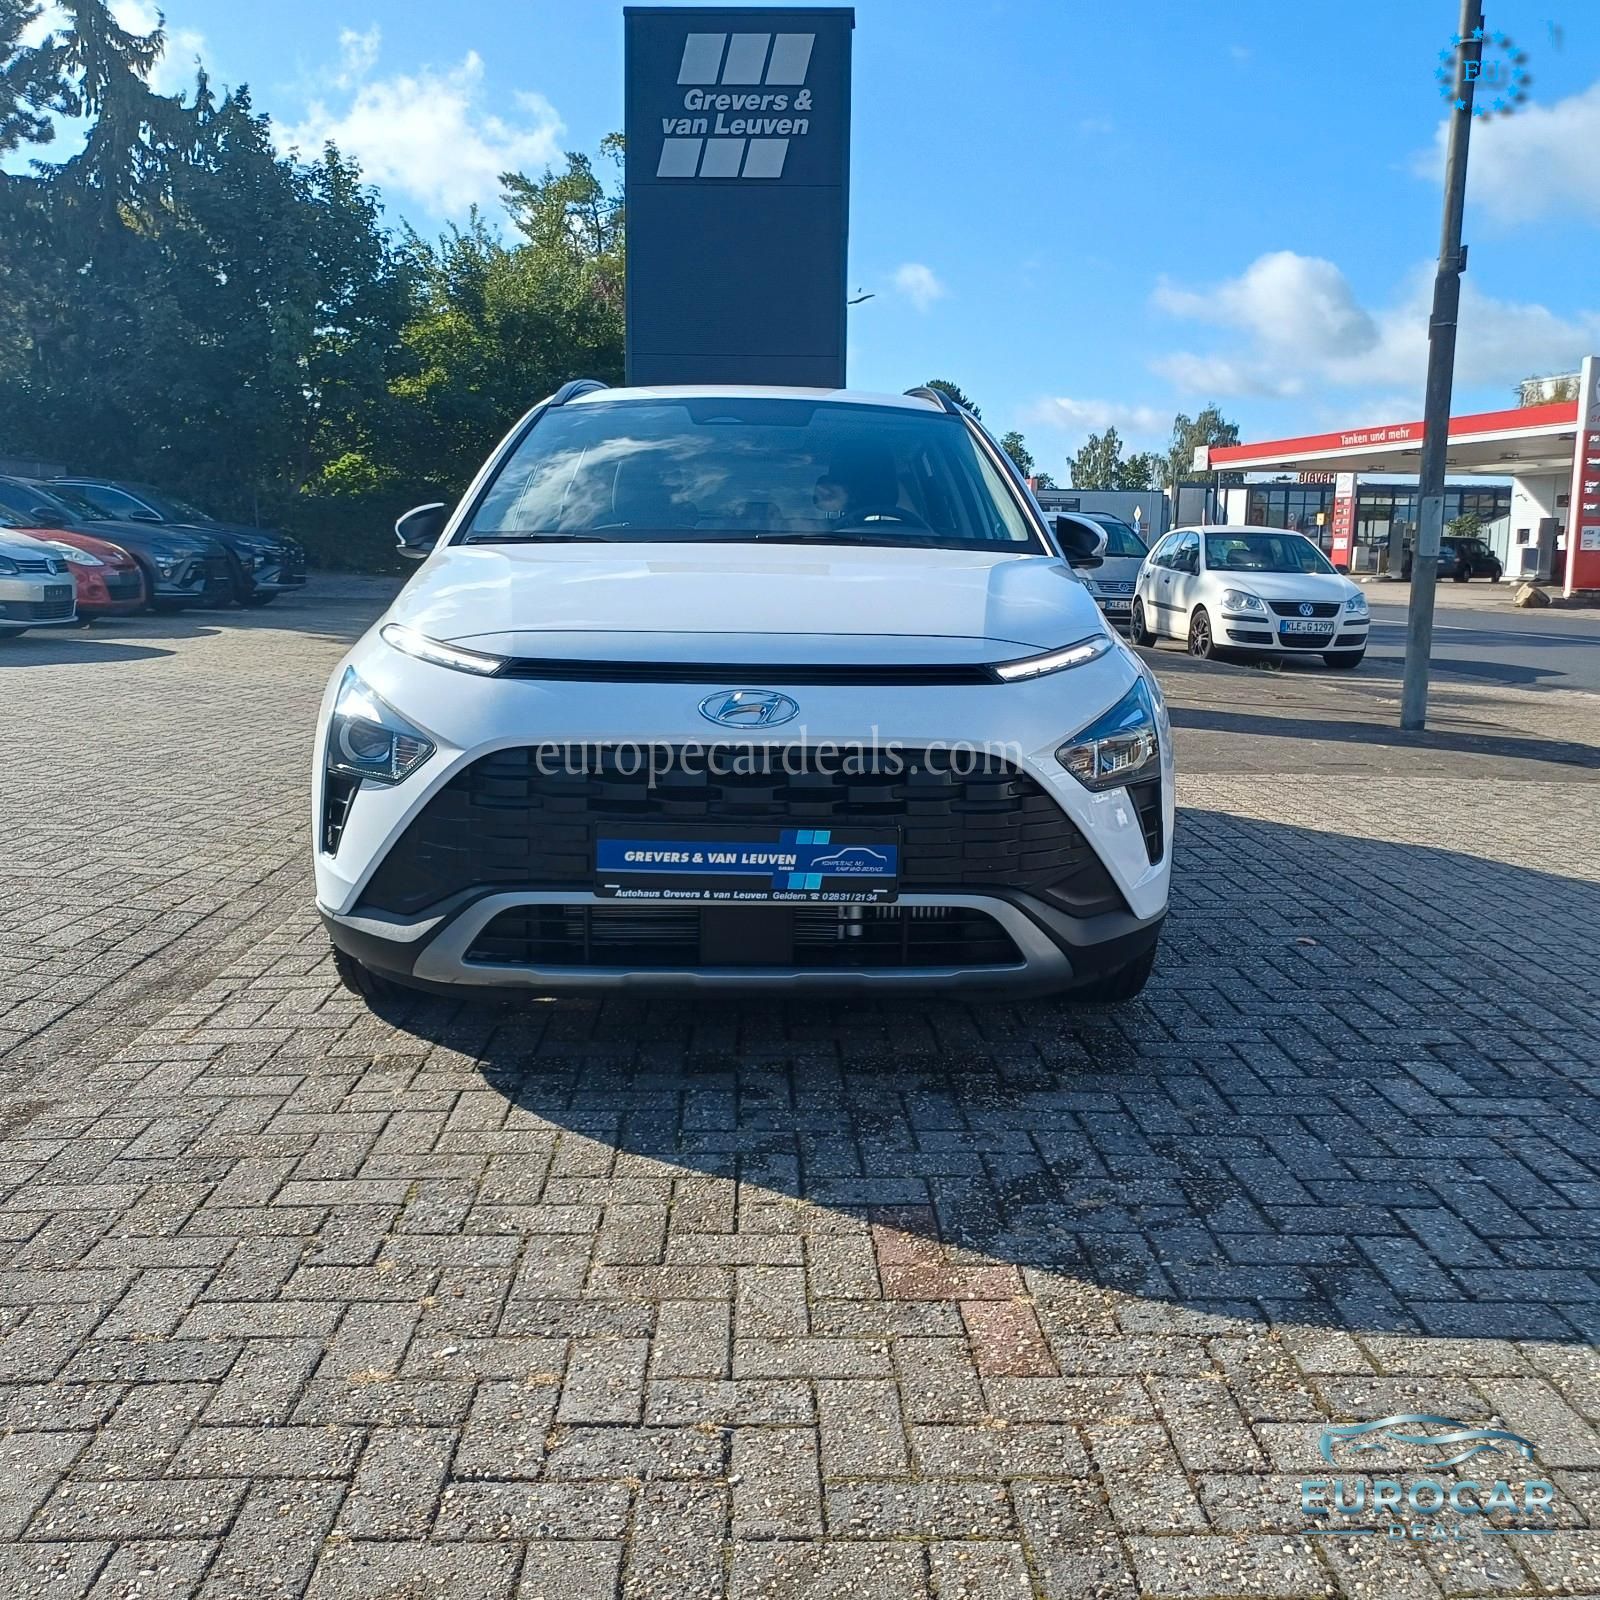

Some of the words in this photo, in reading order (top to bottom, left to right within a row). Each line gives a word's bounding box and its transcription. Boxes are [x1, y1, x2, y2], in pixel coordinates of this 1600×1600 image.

[683, 88, 789, 111] Grevers
[793, 88, 813, 111] &
[661, 117, 708, 135] van
[713, 113, 809, 135] Leuven
[1340, 433, 1368, 446] Tanken
[1370, 428, 1386, 442] und
[1388, 426, 1411, 440] mehr
[1285, 621, 1302, 631] KLE
[1314, 623, 1333, 632] 1297
[624, 851, 690, 863] GREVERS
[691, 852, 704, 863] &
[707, 852, 737, 864] VAN
[741, 853, 797, 866] LEUVEN
[614, 889, 660, 898] Autohaus
[663, 890, 701, 899] Grevers
[703, 890, 710, 898] &
[713, 891, 730, 899] van
[733, 891, 768, 900] Leuven
[772, 892, 806, 901] Geldern
